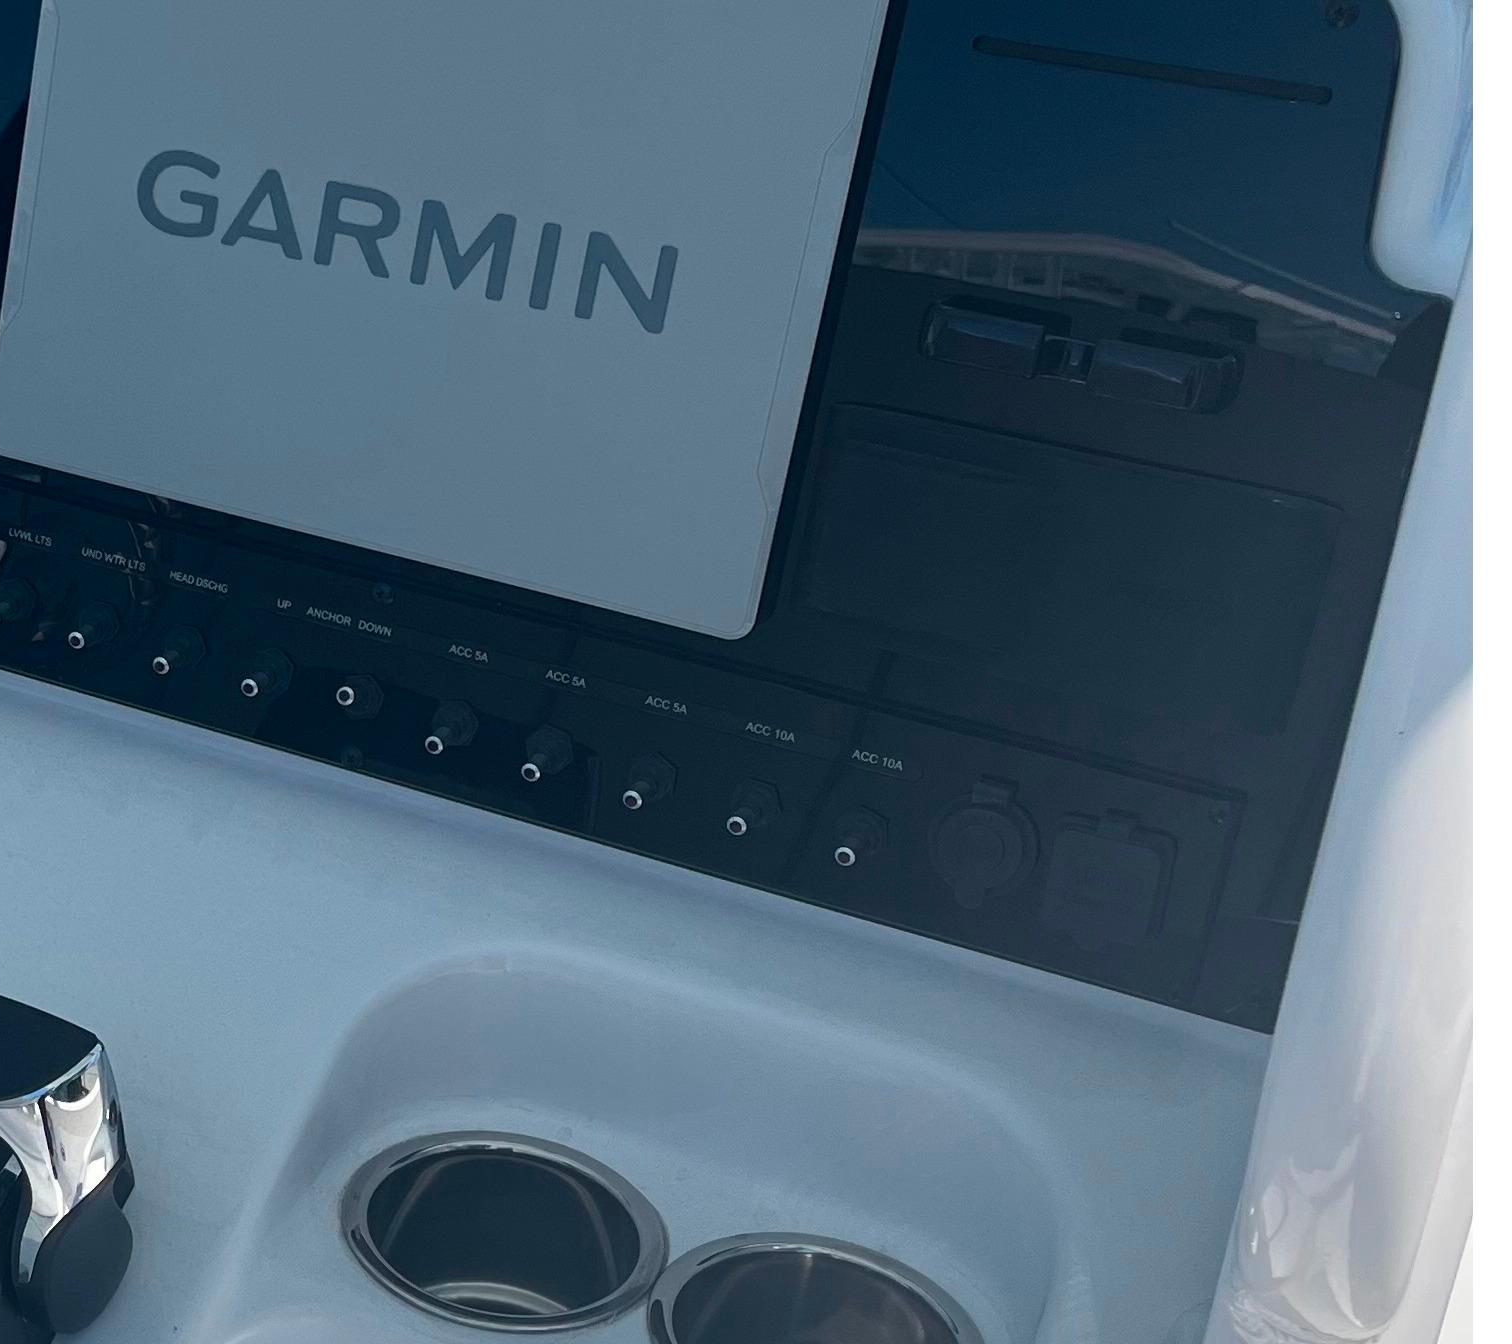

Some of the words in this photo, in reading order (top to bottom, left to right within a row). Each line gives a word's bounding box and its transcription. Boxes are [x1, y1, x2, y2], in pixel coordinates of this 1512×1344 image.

[137, 149, 679, 335] GARMIN
[34, 534, 52, 547] LTS
[81, 546, 103, 561] UND
[104, 551, 127, 567] WTR
[128, 558, 146, 572] LTS
[169, 570, 194, 586] HEAD
[195, 576, 229, 594] DSCHG
[277, 598, 292, 609] UP
[306, 606, 352, 627] ANCHOR
[358, 619, 392, 637] DOWN
[448, 644, 473, 658] ACC
[474, 650, 488, 663] 5A
[545, 669, 570, 685] ACC
[571, 676, 587, 689] 5A
[644, 695, 670, 710] ACC
[672, 702, 688, 715] 5A
[745, 722, 772, 737] ACC
[775, 728, 795, 743] 10A
[851, 749, 879, 765] ACC
[881, 756, 903, 772] 10A
